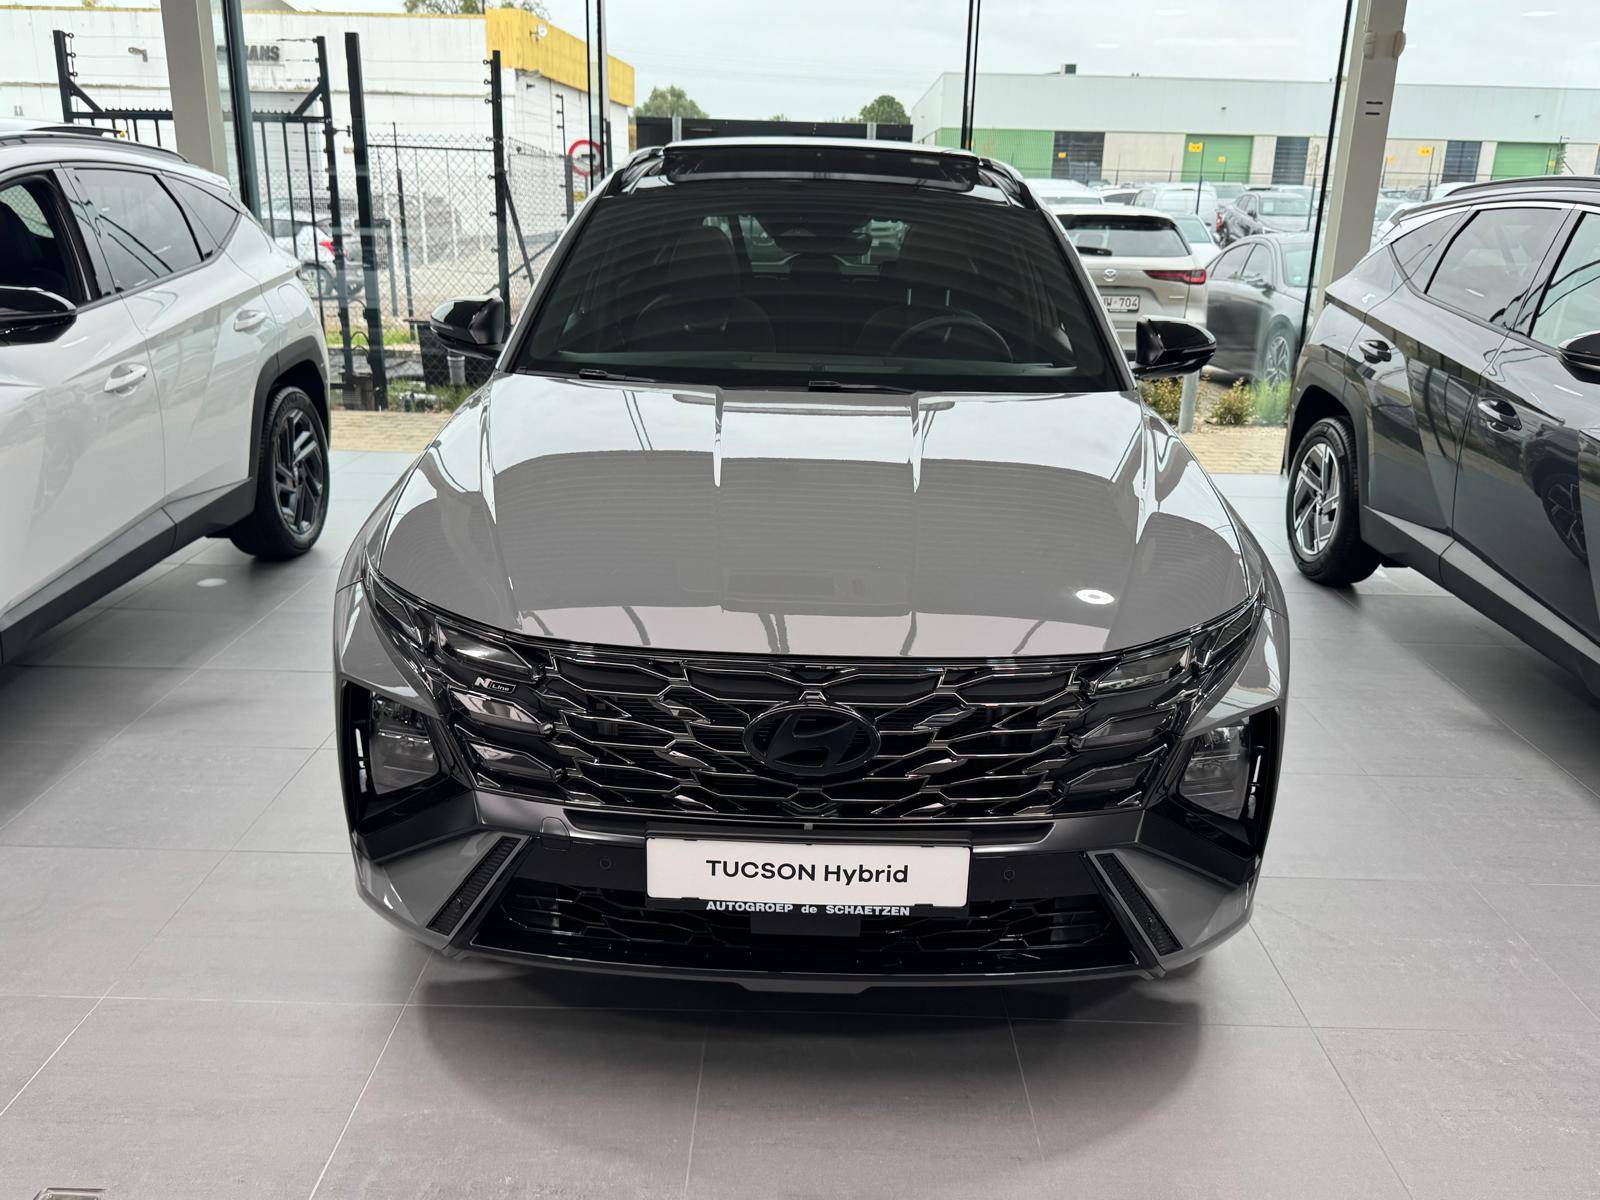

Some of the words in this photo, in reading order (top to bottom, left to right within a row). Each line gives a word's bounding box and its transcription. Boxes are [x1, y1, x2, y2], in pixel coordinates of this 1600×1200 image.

[244, 45, 280, 61] ANS
[492, 684, 510, 692] Line
[705, 859, 816, 881] TUCSON
[823, 864, 909, 886] Hybrid
[705, 901, 794, 913] AUTOGROEP
[800, 904, 818, 914] de
[825, 905, 910, 916] SCHAETZEN
